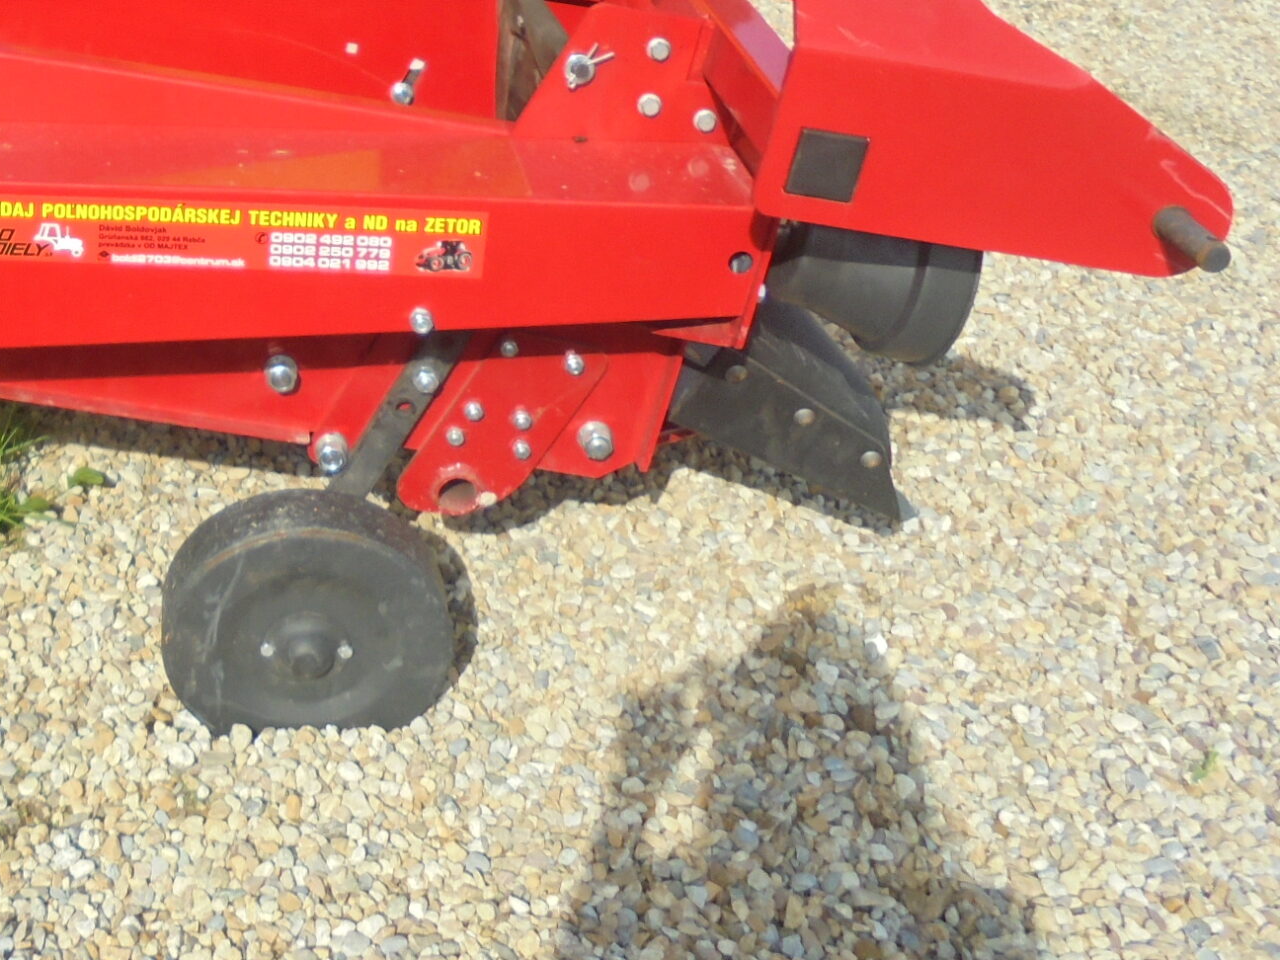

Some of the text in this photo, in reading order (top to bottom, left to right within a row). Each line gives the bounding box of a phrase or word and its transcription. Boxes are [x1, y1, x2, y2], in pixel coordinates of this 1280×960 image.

[248, 209, 338, 230] TECHNIKY
[344, 216, 356, 230] a
[363, 214, 388, 232] ND
[395, 218, 418, 233] na
[424, 216, 482, 235] ZETOR
